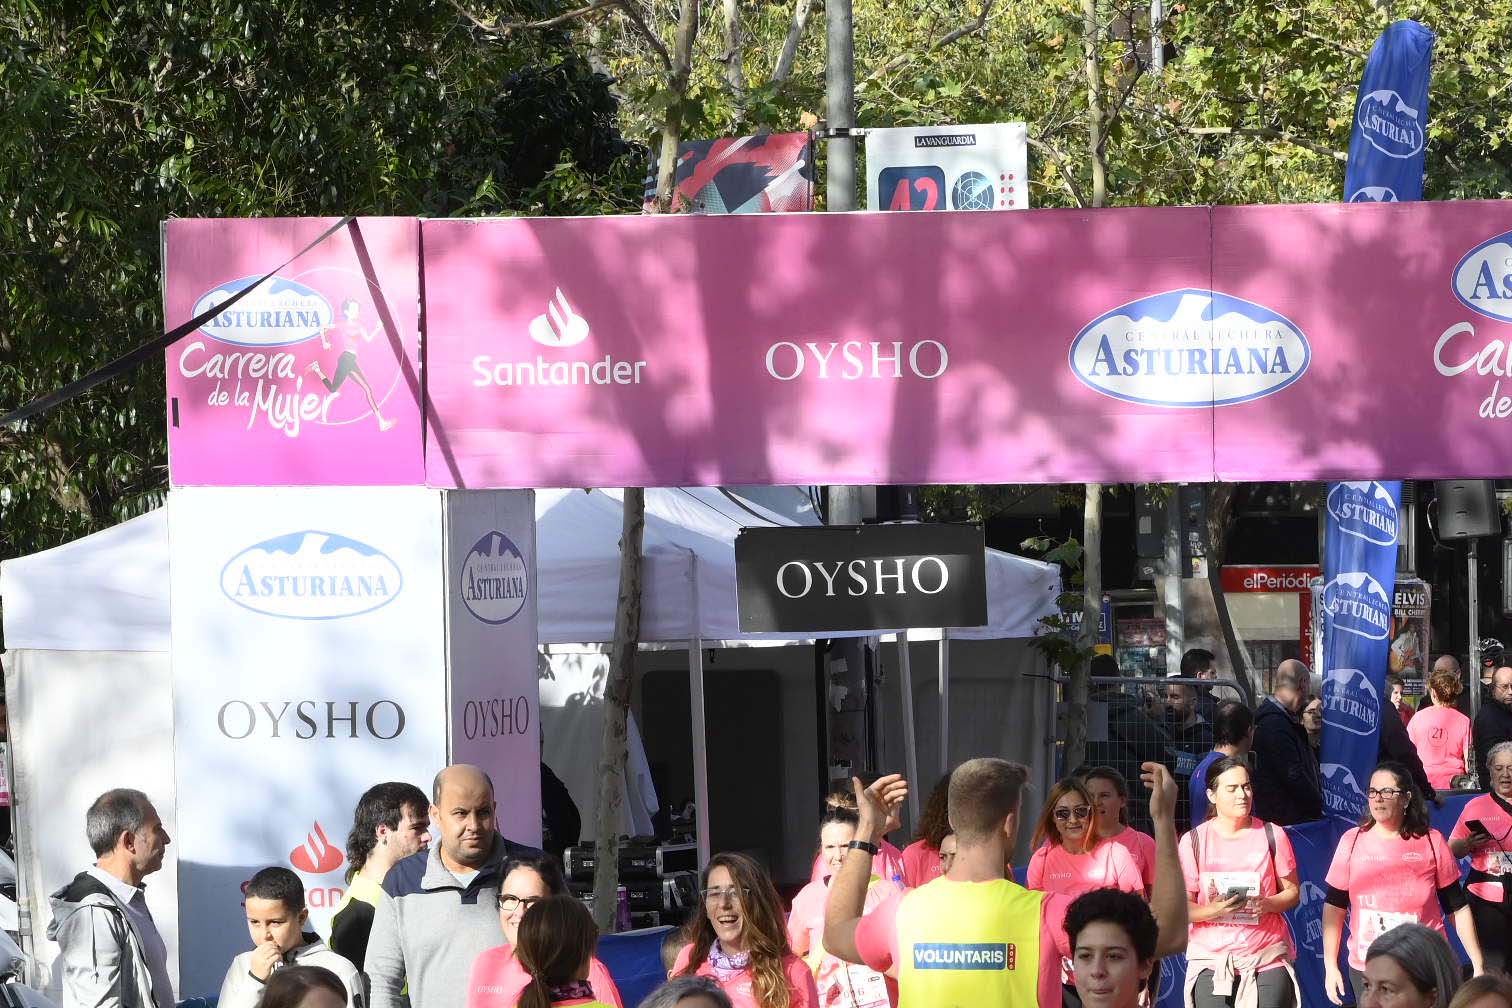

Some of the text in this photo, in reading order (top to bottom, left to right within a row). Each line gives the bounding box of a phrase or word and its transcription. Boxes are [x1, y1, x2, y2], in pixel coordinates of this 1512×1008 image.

[179, 342, 296, 379] Carrera
[472, 355, 647, 387] Santander
[765, 339, 949, 380] OYSHO
[1089, 334, 1292, 377] ASTURIANA
[208, 374, 340, 437] de la Mujer
[1479, 381, 1512, 419] de
[235, 564, 389, 597] ASTURIANA
[467, 567, 524, 600] ASTURIANA
[776, 555, 950, 599] OYSHO
[1394, 593, 1425, 605] ELVIS
[217, 700, 405, 739] OYSHO
[464, 695, 529, 740] OYSHO
[914, 949, 1003, 964] VOLUNTARIS
